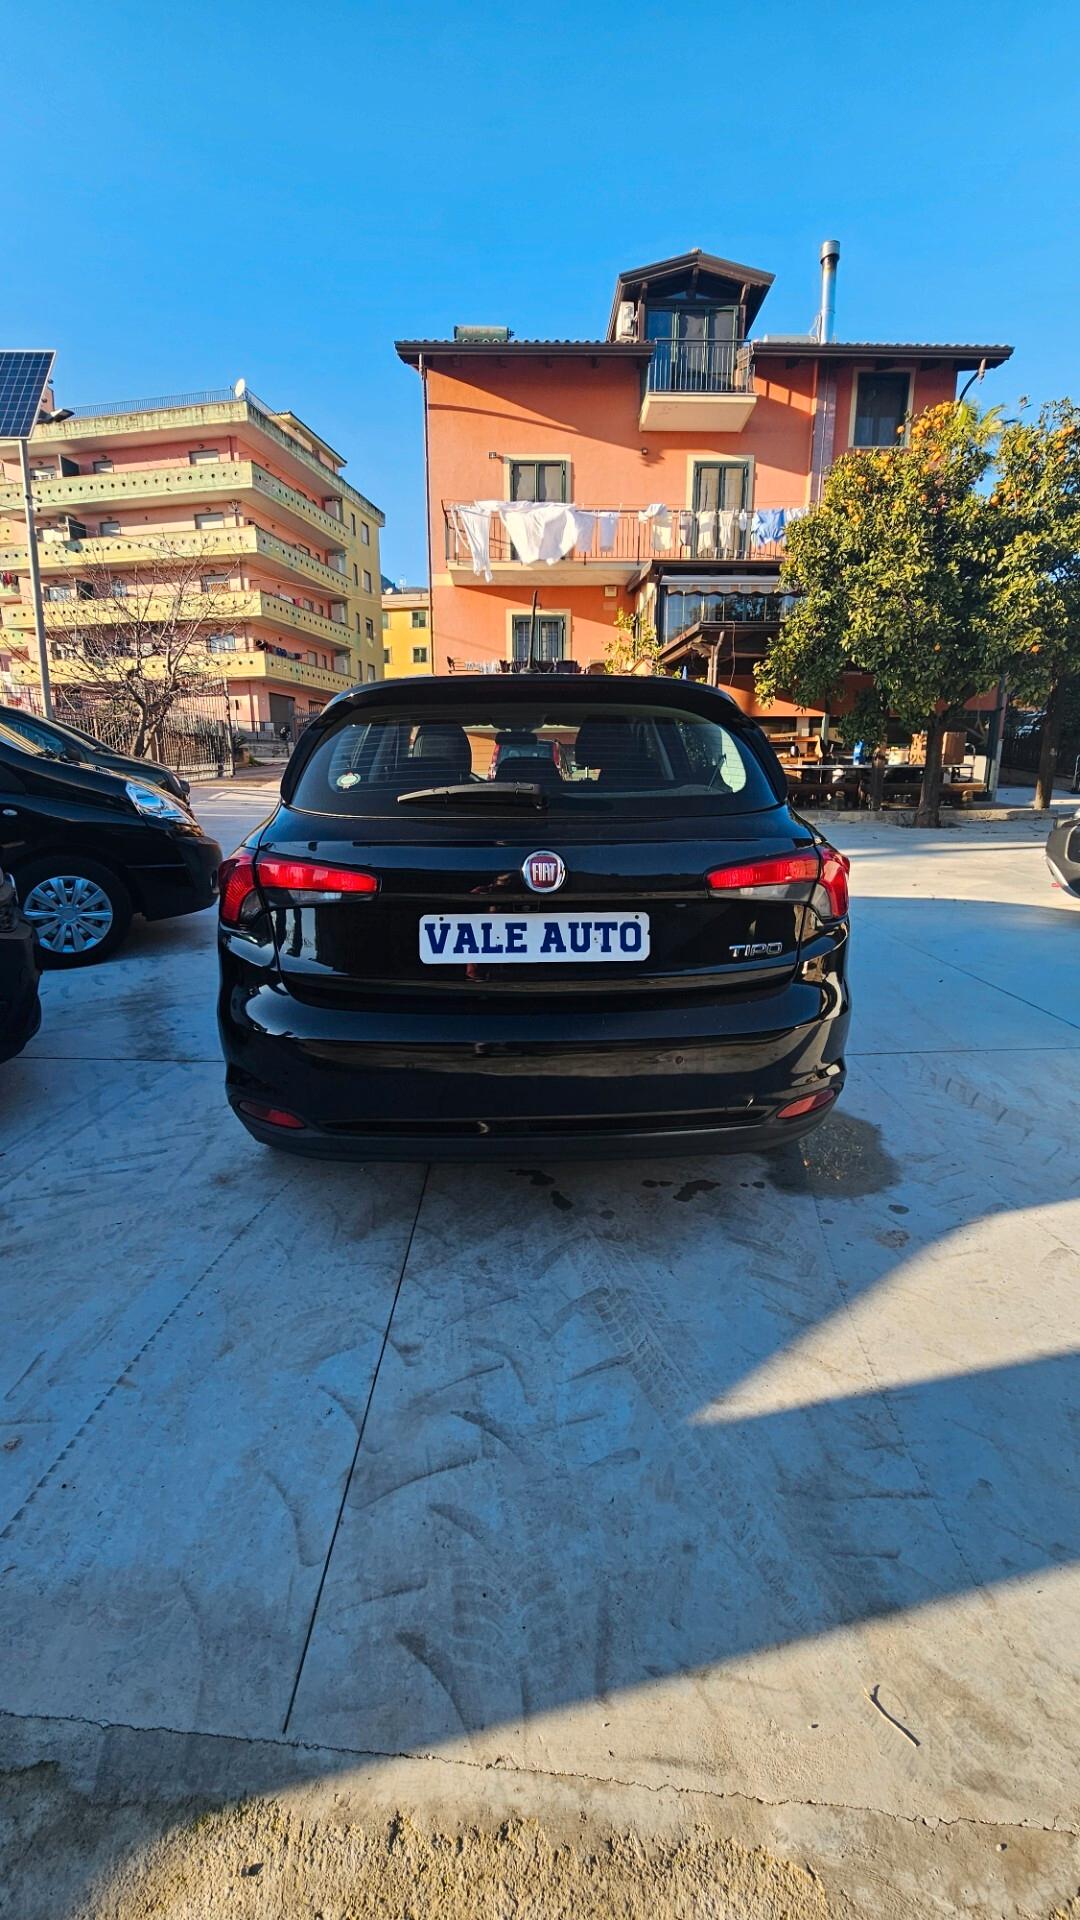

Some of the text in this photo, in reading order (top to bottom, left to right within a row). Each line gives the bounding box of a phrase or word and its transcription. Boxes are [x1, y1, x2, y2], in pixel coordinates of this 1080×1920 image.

[532, 862, 556, 882] FIAT
[424, 921, 642, 954] VALE AUTO
[729, 942, 783, 958] TIPO
